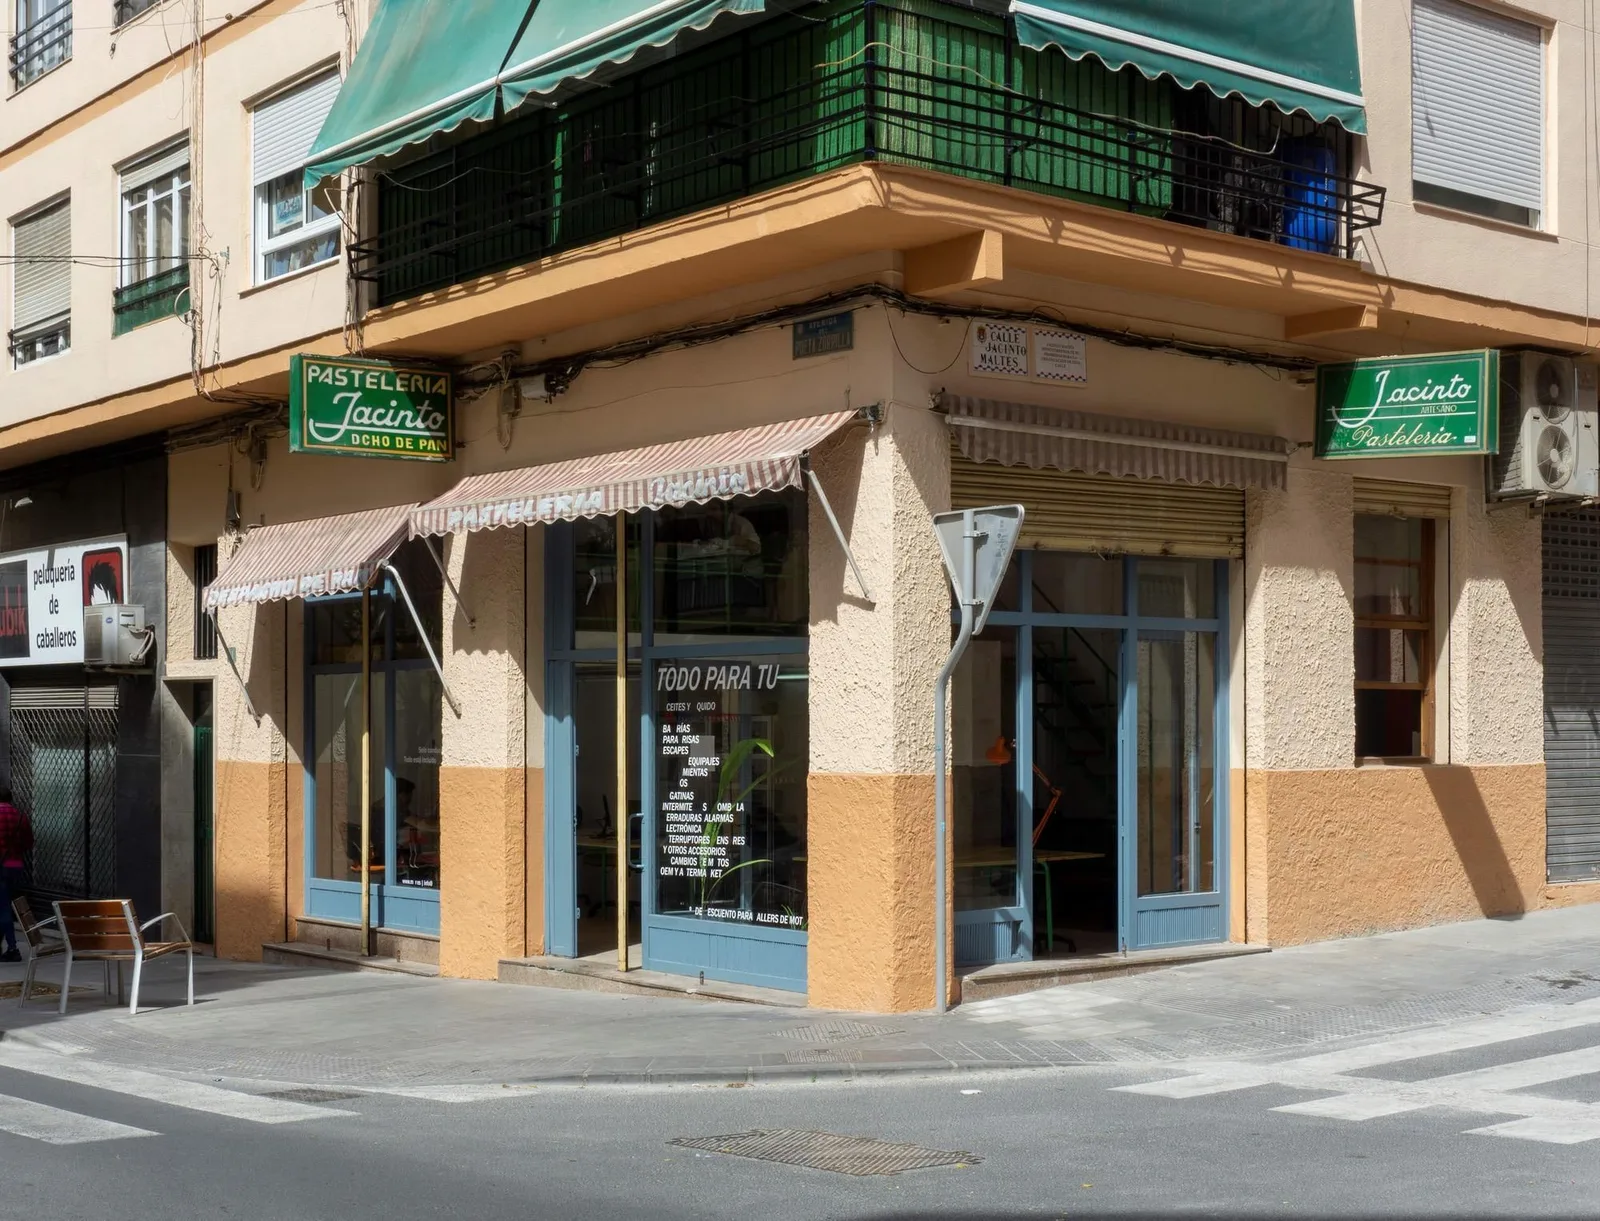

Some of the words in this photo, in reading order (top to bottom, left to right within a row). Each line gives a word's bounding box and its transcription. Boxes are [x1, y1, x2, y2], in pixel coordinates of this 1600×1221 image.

[990, 331, 1020, 343] CALLE
[985, 342, 1027, 356] JACINTO
[980, 353, 1019, 367] MALTES
[307, 364, 447, 396] PASTELERIA
[1331, 369, 1472, 429] Jacinto
[1420, 403, 1458, 415] ARTESANO
[308, 390, 446, 443] Jacinto
[351, 433, 391, 448] DCHO
[395, 435, 414, 450] DE
[419, 438, 448, 452] PAN
[650, 467, 747, 504] Jacinto
[449, 490, 603, 527] PASTELERIA
[33, 558, 76, 590] peluquería
[300, 573, 325, 592] DE
[49, 594, 59, 615] de
[36, 626, 77, 649] caballeros
[657, 666, 701, 692] TODO
[704, 665, 751, 691] PARA
[757, 664, 780, 690] TU
[696, 701, 716, 712] QUIDO
[662, 735, 679, 744] PARA
[662, 745, 689, 755] ESCAPES
[688, 756, 720, 767] EQUIPAJES
[682, 767, 709, 777] MIENTAS
[679, 778, 688, 788] OS
[666, 813, 703, 823] ERRADURAS
[703, 813, 734, 823] ALARMAS
[662, 845, 668, 854] Y
[667, 845, 688, 855] OTROS
[687, 846, 727, 856] ACCESORIOS
[670, 856, 698, 867] CAMBIOS
[660, 866, 674, 876] OEM
[694, 906, 703, 916] DE
[707, 907, 737, 919] ESCUENTO
[736, 910, 754, 922] PARA
[756, 912, 780, 924] ALLERS
[779, 914, 789, 925] DE
